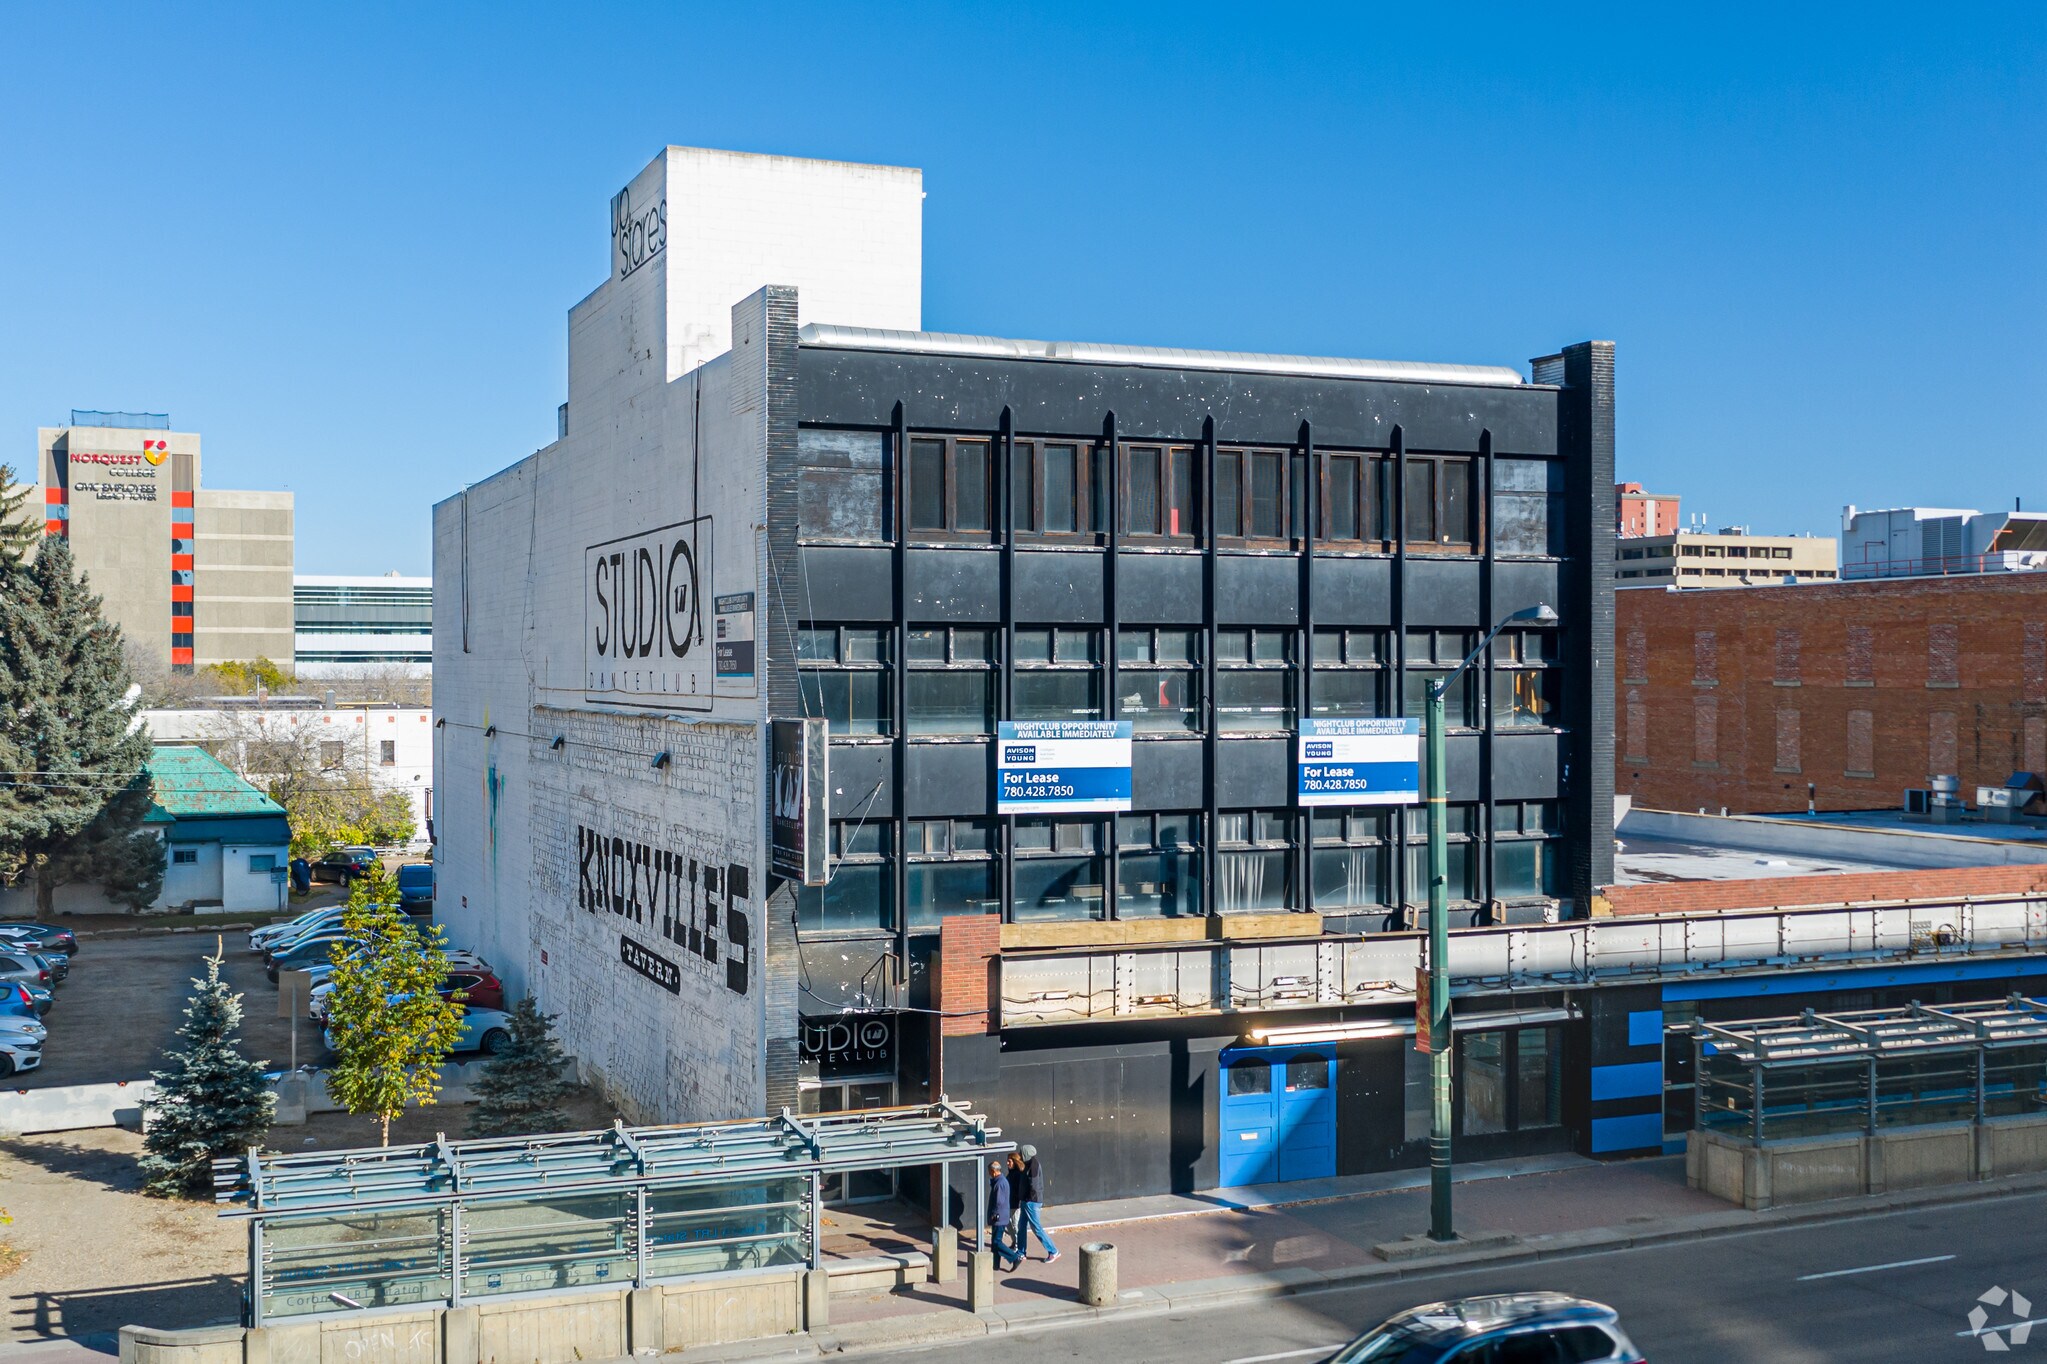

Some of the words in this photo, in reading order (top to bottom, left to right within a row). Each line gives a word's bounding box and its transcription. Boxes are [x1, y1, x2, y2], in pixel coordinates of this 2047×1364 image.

[70, 453, 142, 466] NORQUEST
[109, 468, 156, 478] COLLEGE
[75, 482, 99, 492] CIVIC
[102, 483, 157, 493] EMPLOYEES
[96, 493, 125, 501] LEGACY
[129, 493, 157, 501] TOWER
[596, 539, 696, 659] STUDIO
[1014, 722, 1060, 731] NIGHTCLUB
[1061, 722, 1118, 730] OPPORTUNITY
[1313, 720, 1355, 728] NIGHTCLUB
[1356, 720, 1407, 728] OPPORTUNITY
[1017, 730, 1061, 738] AVAILABLE
[1062, 730, 1116, 738] IMMEDIATELY
[1356, 727, 1404, 735] IMMEDIATELY
[1004, 773, 1024, 783] For
[1026, 772, 1059, 783] Lease
[1304, 767, 1321, 777] For
[1324, 767, 1354, 777] Lease
[1304, 779, 1367, 790] 780.428.7850
[1004, 786, 1074, 797] 780.428.7850
[578, 825, 749, 995] KNOXVILLE'S
[627, 944, 673, 985] TAVERN
[519, 1273, 532, 1282] To
[286, 1295, 334, 1307] Coron
[347, 1288, 369, 1299] LRT
